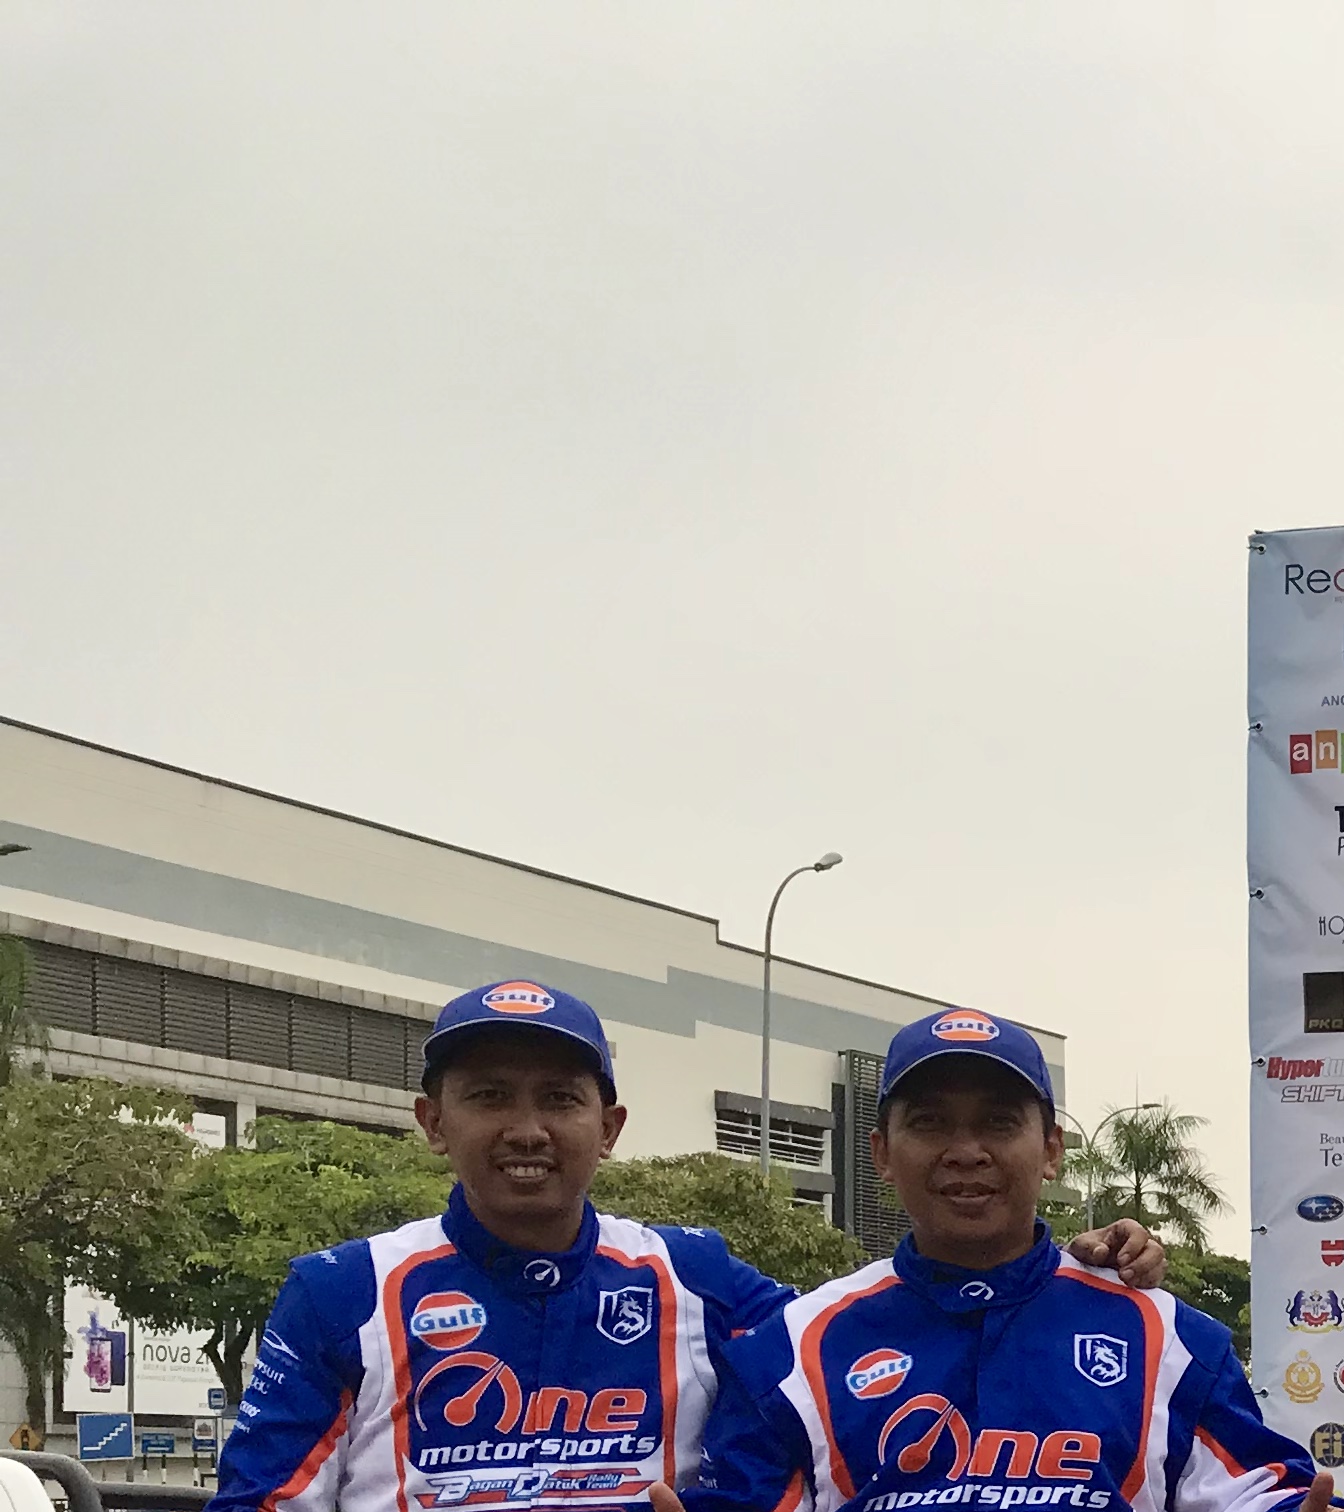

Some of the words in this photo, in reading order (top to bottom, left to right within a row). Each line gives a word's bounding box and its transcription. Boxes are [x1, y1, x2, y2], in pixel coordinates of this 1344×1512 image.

[485, 993, 552, 1005] Gulf
[936, 1020, 997, 1034] Gulf
[413, 1306, 486, 1334] Gulf
[143, 1344, 190, 1363] nova
[850, 1354, 911, 1389] Gulf
[418, 1434, 656, 1467] motorsports
[427, 1475, 514, 1502] Bagan
[507, 1470, 581, 1499] Datuk
[586, 1481, 618, 1489] Team
[863, 1484, 1111, 1512] motorsports
